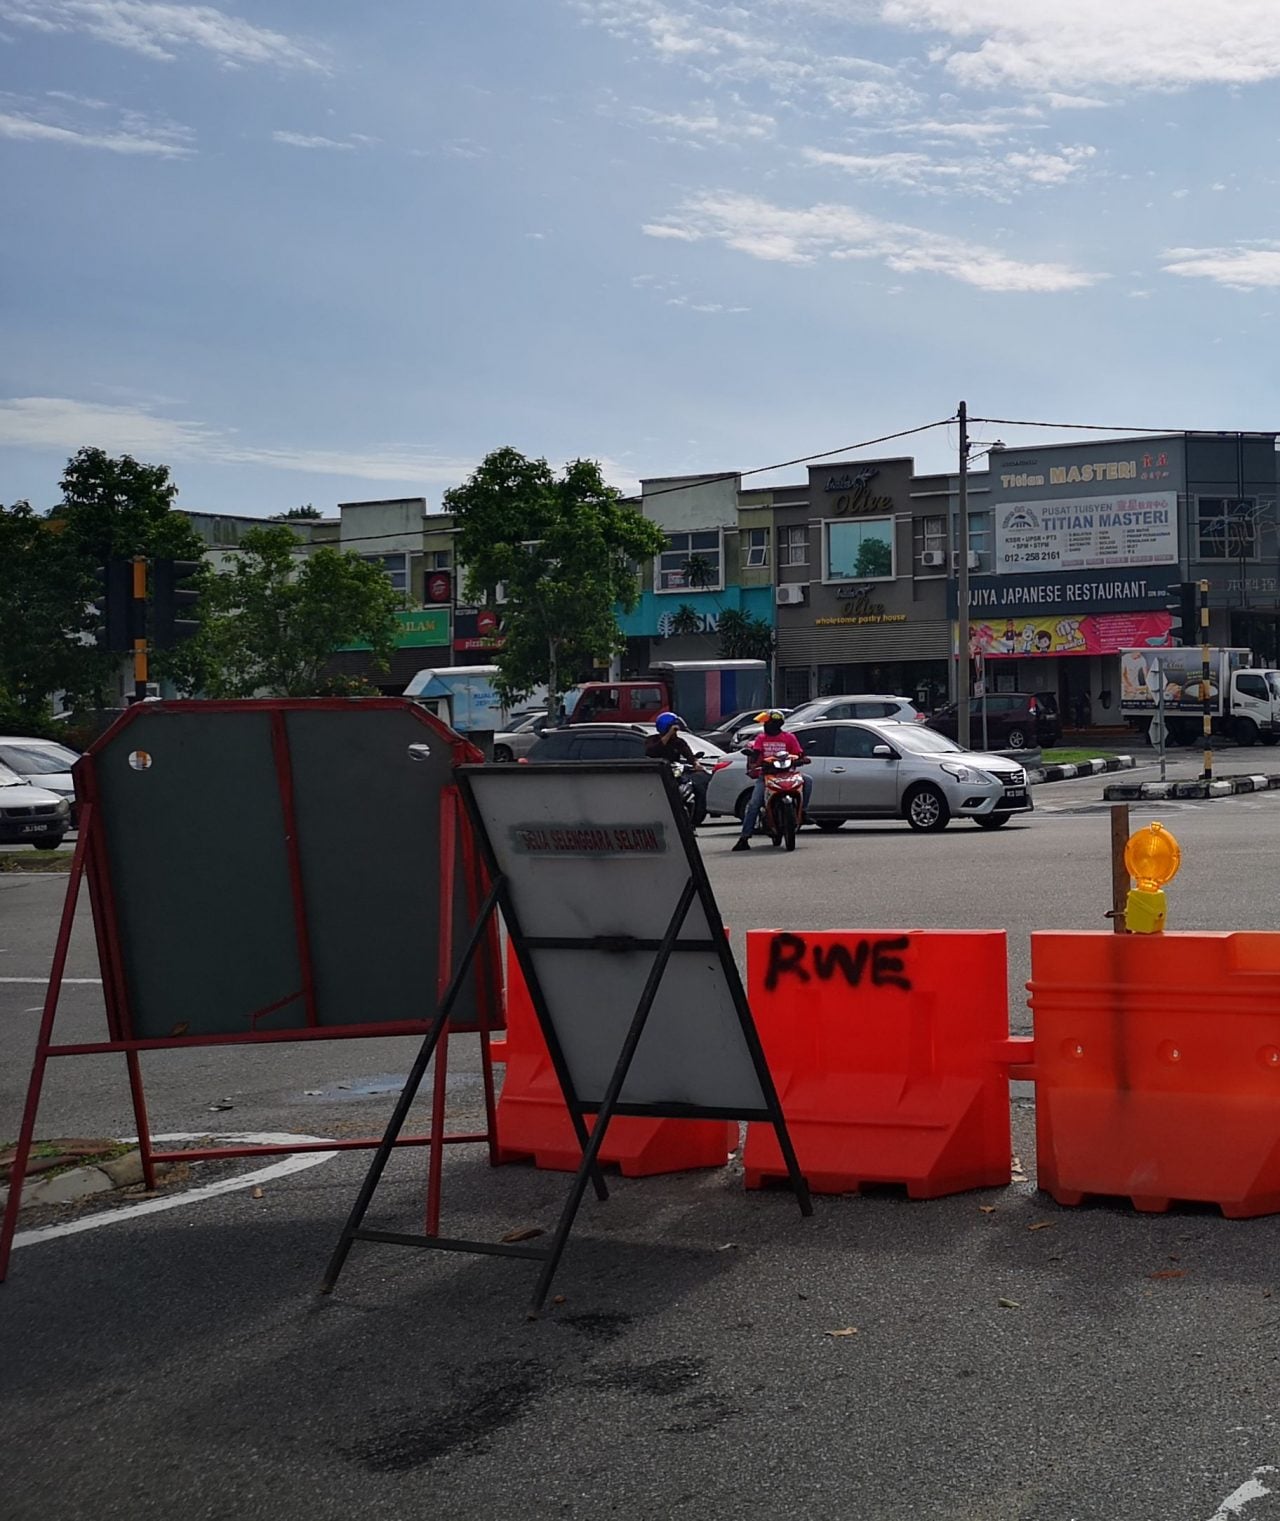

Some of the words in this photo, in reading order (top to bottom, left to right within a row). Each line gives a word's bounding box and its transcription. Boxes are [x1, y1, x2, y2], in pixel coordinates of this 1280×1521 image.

[1001, 474, 1044, 488] Titian
[1050, 461, 1137, 484] MASTERI
[1042, 506, 1072, 516] PUSAT
[1074, 503, 1113, 513] TUISYEN
[1041, 516, 1094, 531] TITIAN
[1099, 510, 1169, 527] MASTERI
[1001, 585, 1061, 604] JAPANESE
[1066, 580, 1147, 601] RESTAURANT
[815, 617, 856, 625] wholesome
[883, 613, 906, 622] house
[613, 830, 659, 850] SELATAN
[764, 932, 912, 992] RWE
